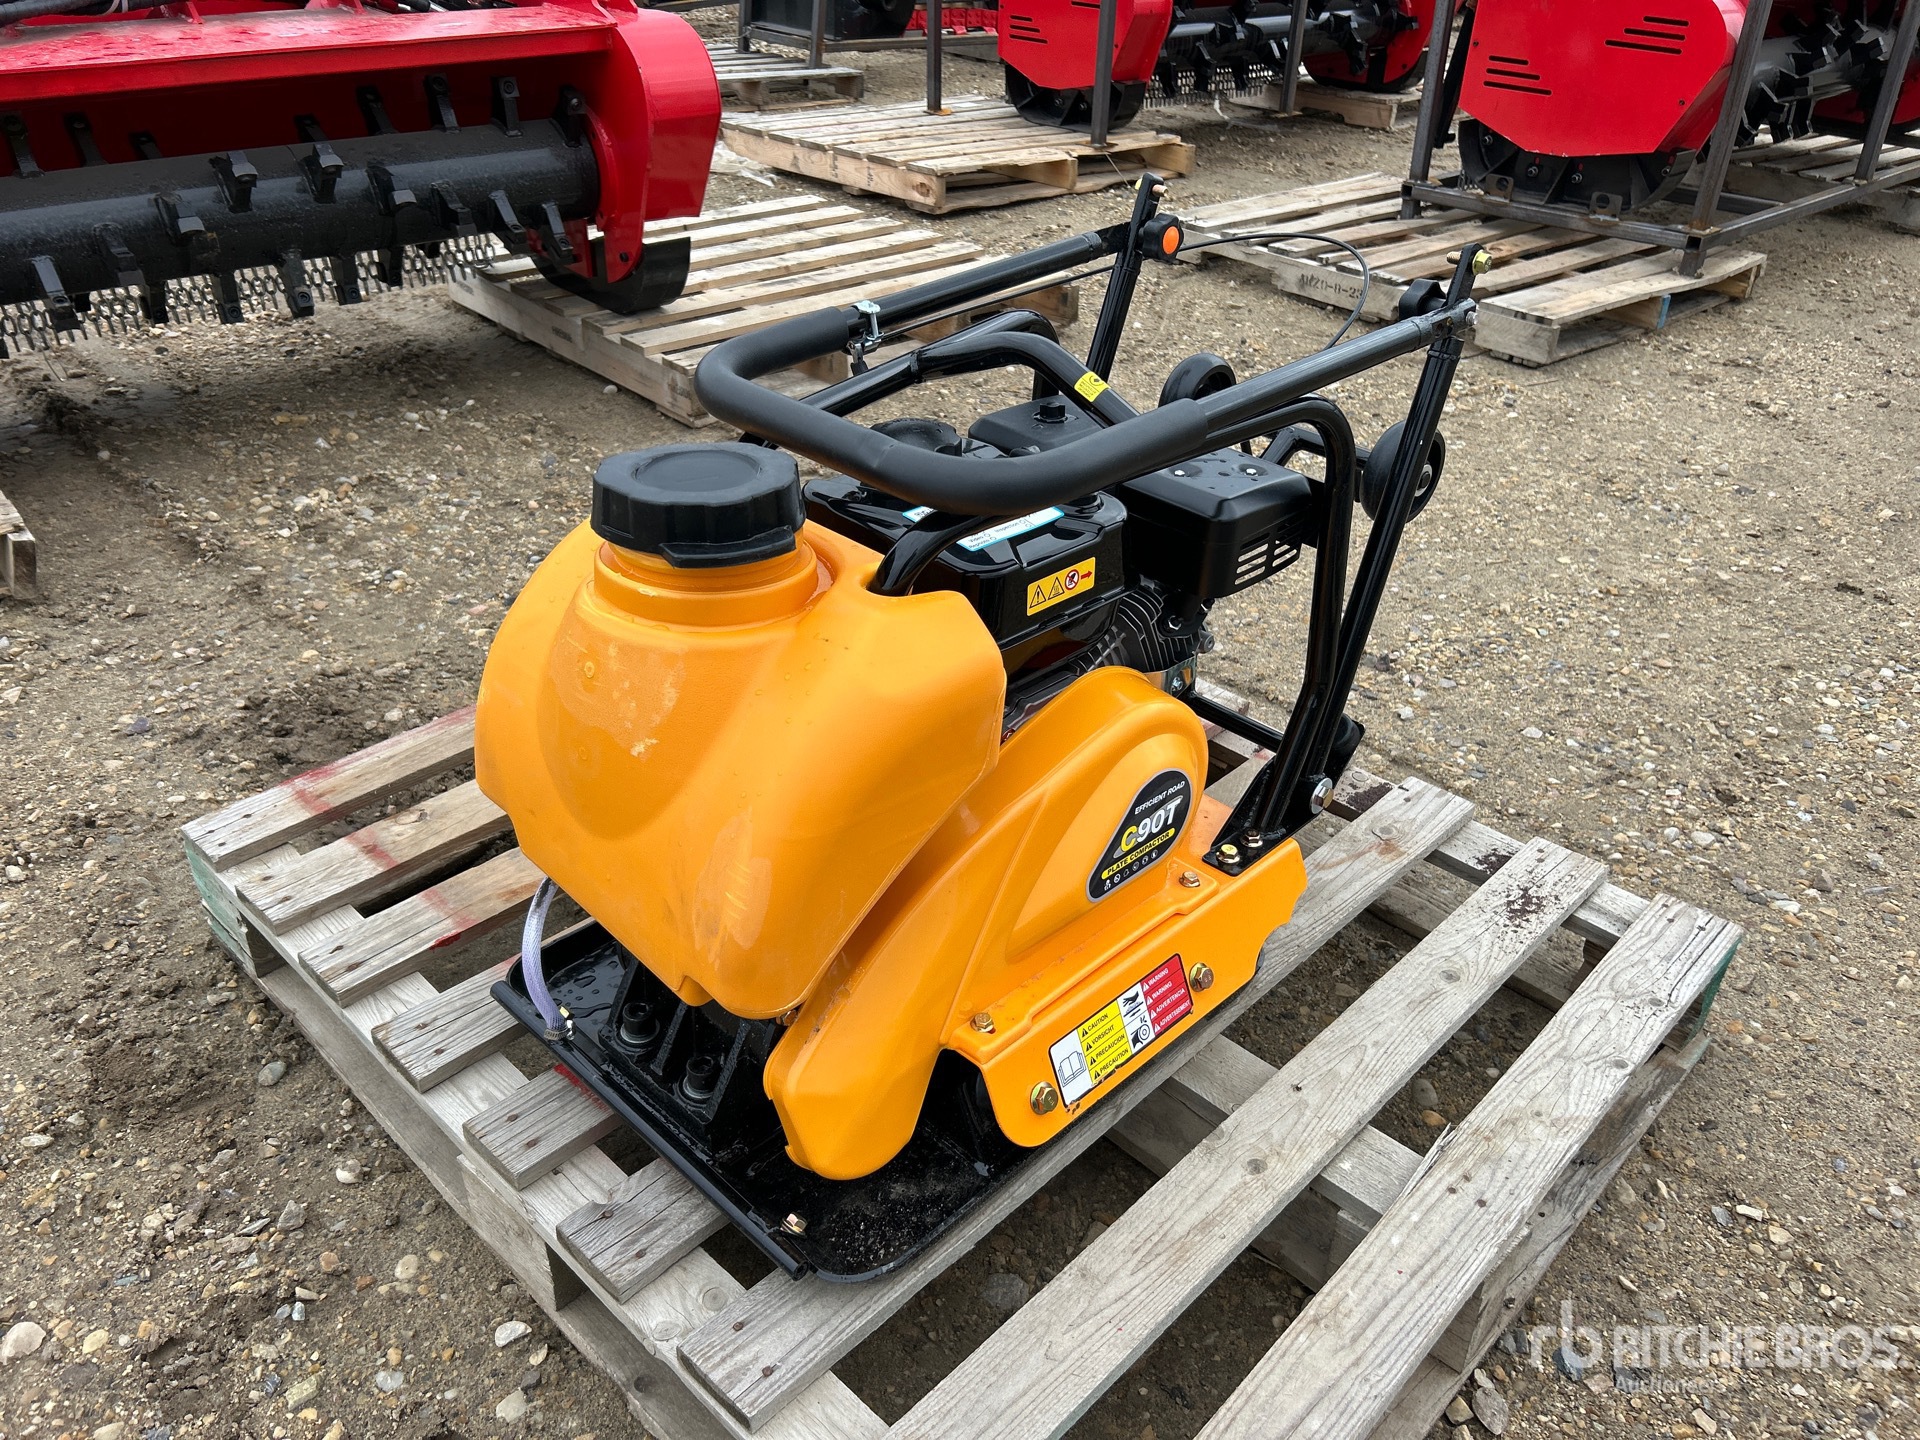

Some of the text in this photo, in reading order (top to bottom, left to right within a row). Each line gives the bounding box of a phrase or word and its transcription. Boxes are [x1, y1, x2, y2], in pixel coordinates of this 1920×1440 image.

[1134, 781, 1185, 815] EFFICIENT ROAD
[1120, 798, 1182, 852] C90T
[1107, 831, 1170, 876] PLATE COMPACTOR
[1148, 968, 1169, 986] WARNING
[1151, 981, 1173, 999] WARNING
[1155, 987, 1186, 1013] ADVERTENCIA
[1087, 1013, 1108, 1032] CAUTION
[1091, 1024, 1115, 1045] VORSICHT
[1099, 1048, 1129, 1074] PRECAUTION
